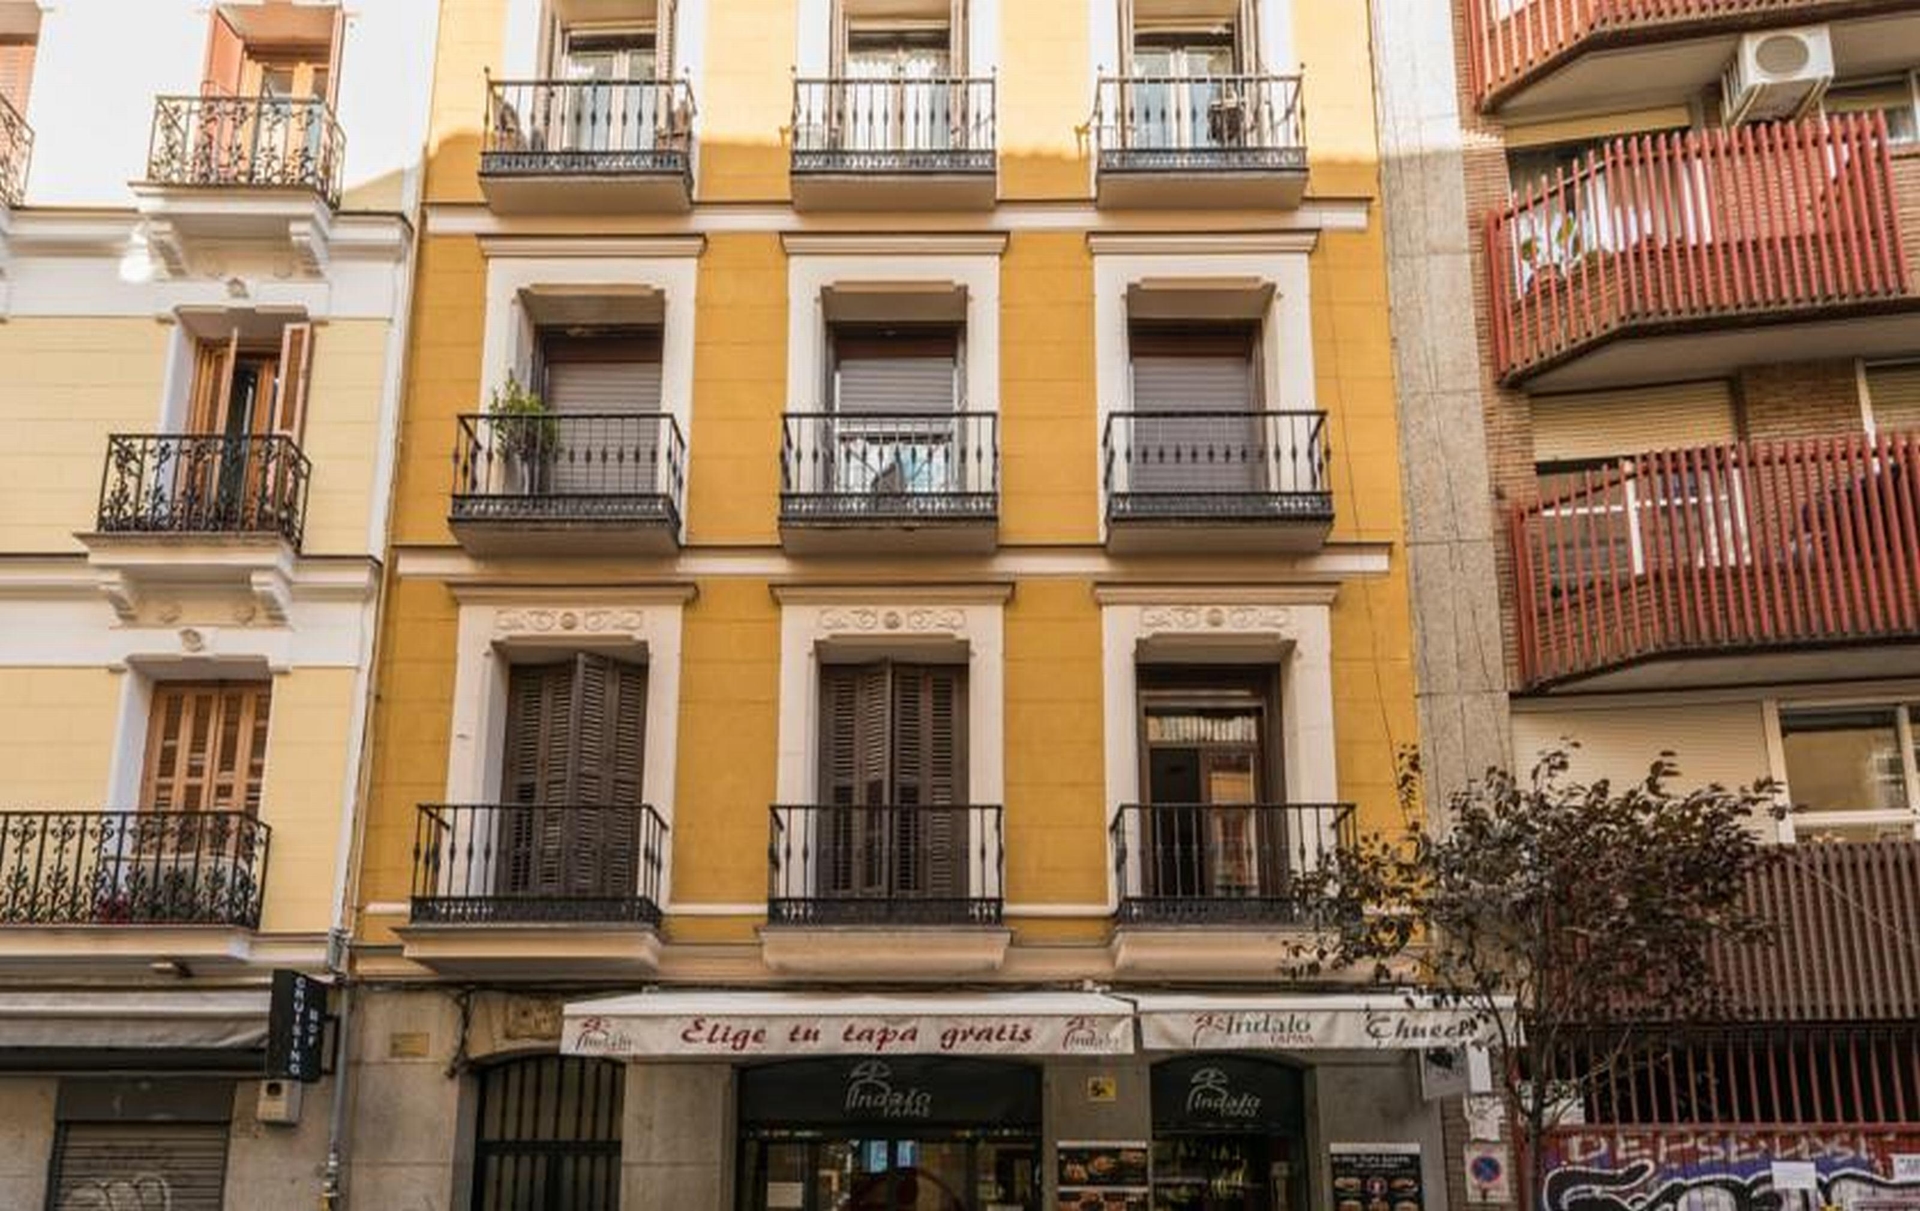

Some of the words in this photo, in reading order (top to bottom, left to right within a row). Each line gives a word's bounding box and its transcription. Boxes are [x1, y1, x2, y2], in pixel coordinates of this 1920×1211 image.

[681, 1016, 766, 1051] Elige
[789, 1024, 820, 1043] tu
[842, 1023, 918, 1051] tapa
[940, 1023, 1032, 1049] gratis
[1226, 1013, 1311, 1034] Indalo
